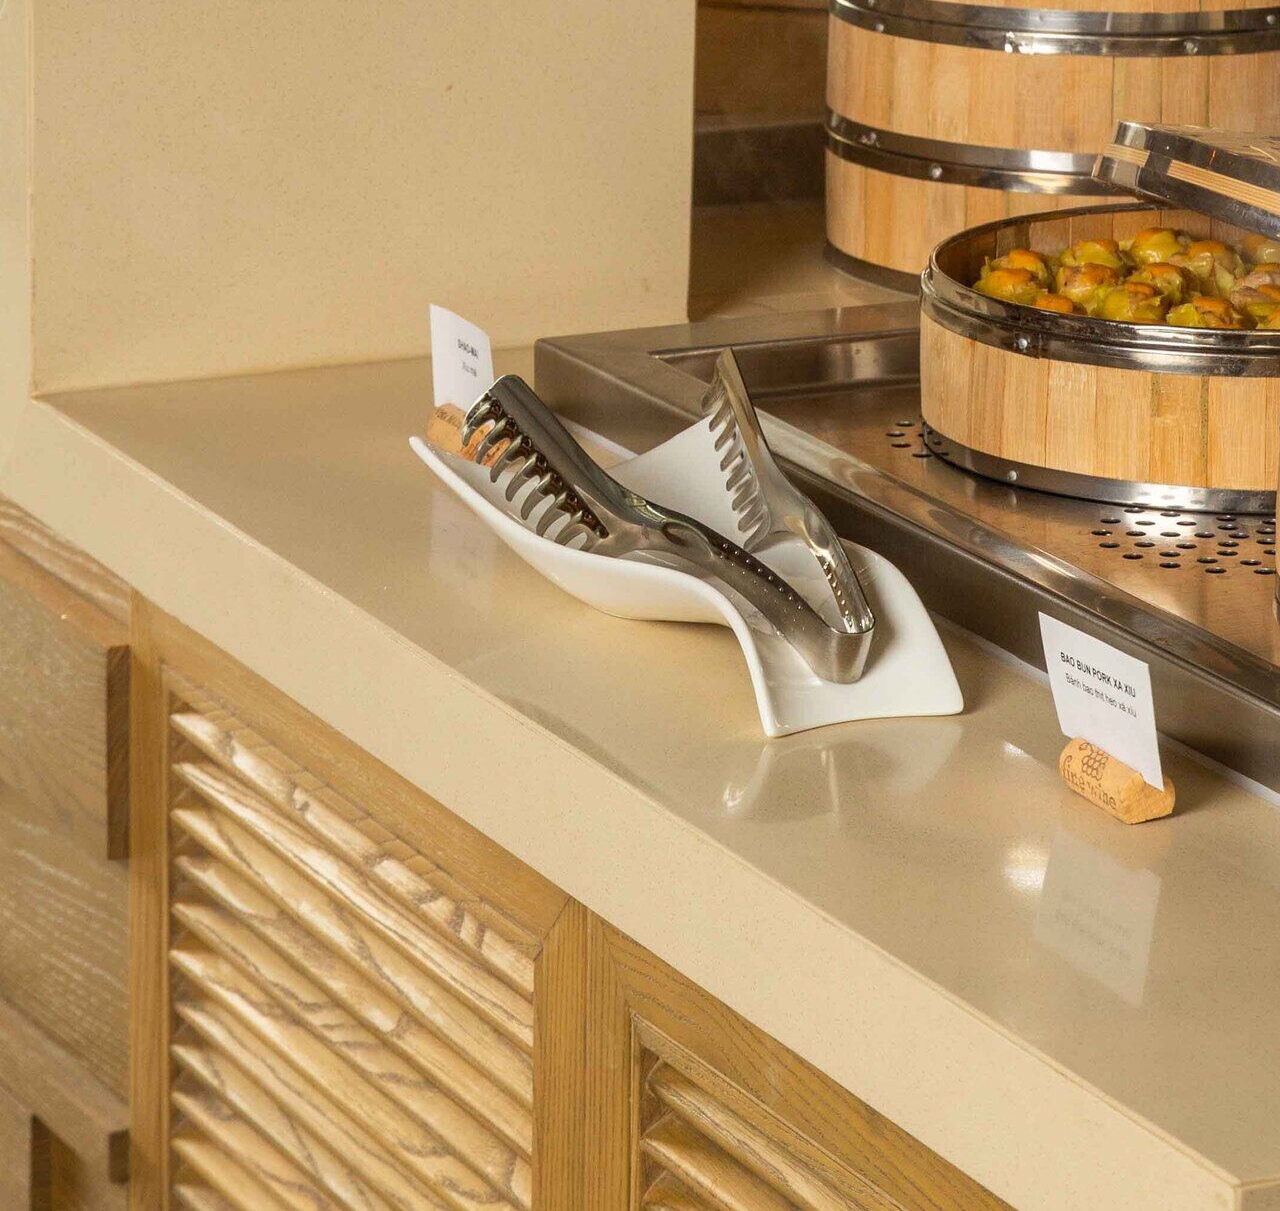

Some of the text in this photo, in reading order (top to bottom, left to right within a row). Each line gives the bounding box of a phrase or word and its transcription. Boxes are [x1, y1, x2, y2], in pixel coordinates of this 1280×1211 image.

[1060, 651, 1075, 667] BAO
[1076, 659, 1091, 676] BUN
[1092, 667, 1112, 686] PORK
